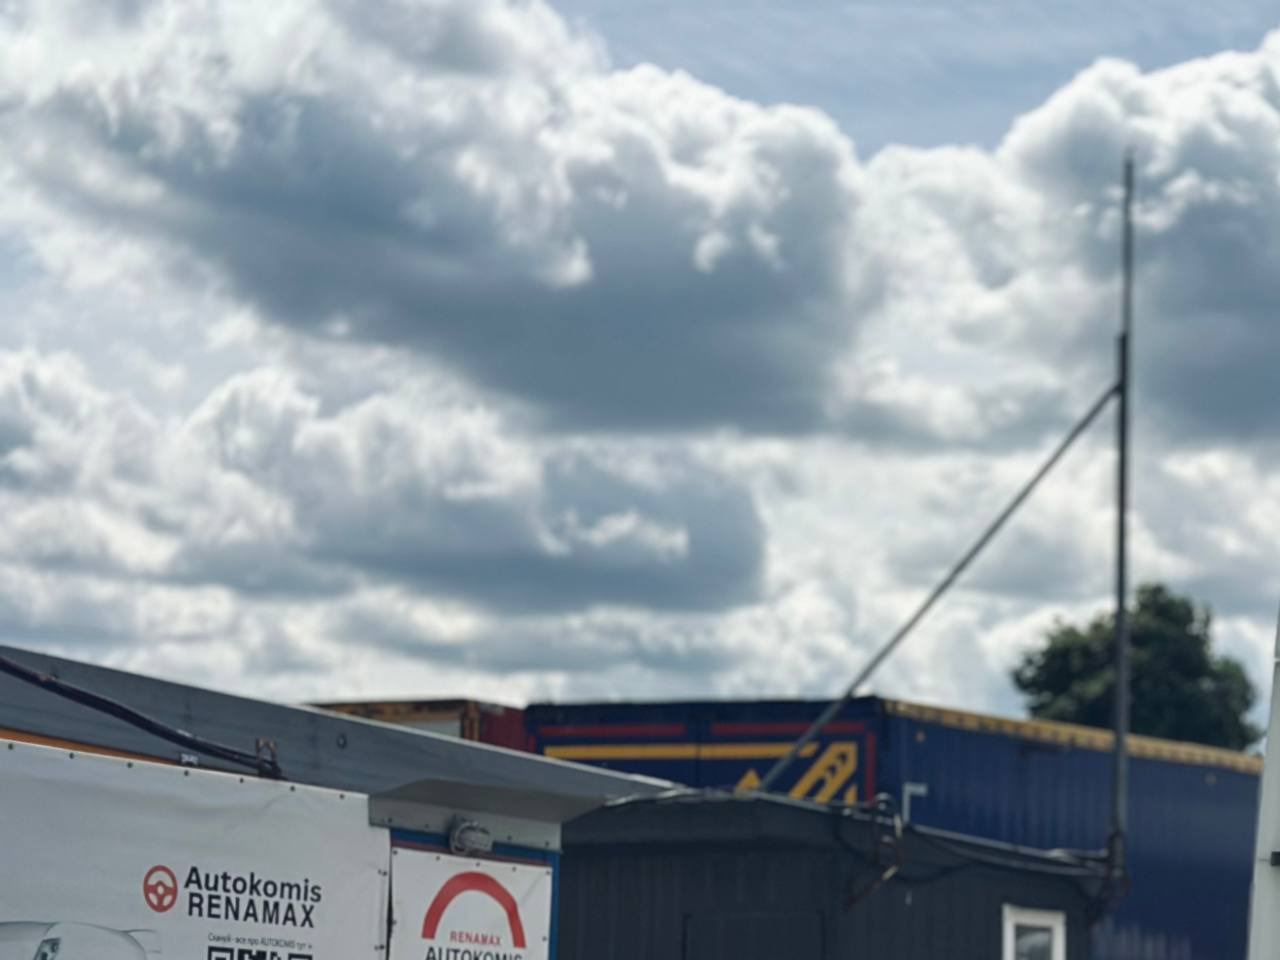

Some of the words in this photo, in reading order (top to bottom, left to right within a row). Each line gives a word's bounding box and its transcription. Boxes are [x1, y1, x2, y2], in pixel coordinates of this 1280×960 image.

[184, 866, 323, 903] Autokomis
[188, 892, 315, 928] RENAMAX
[450, 931, 502, 946] RENAMAX
